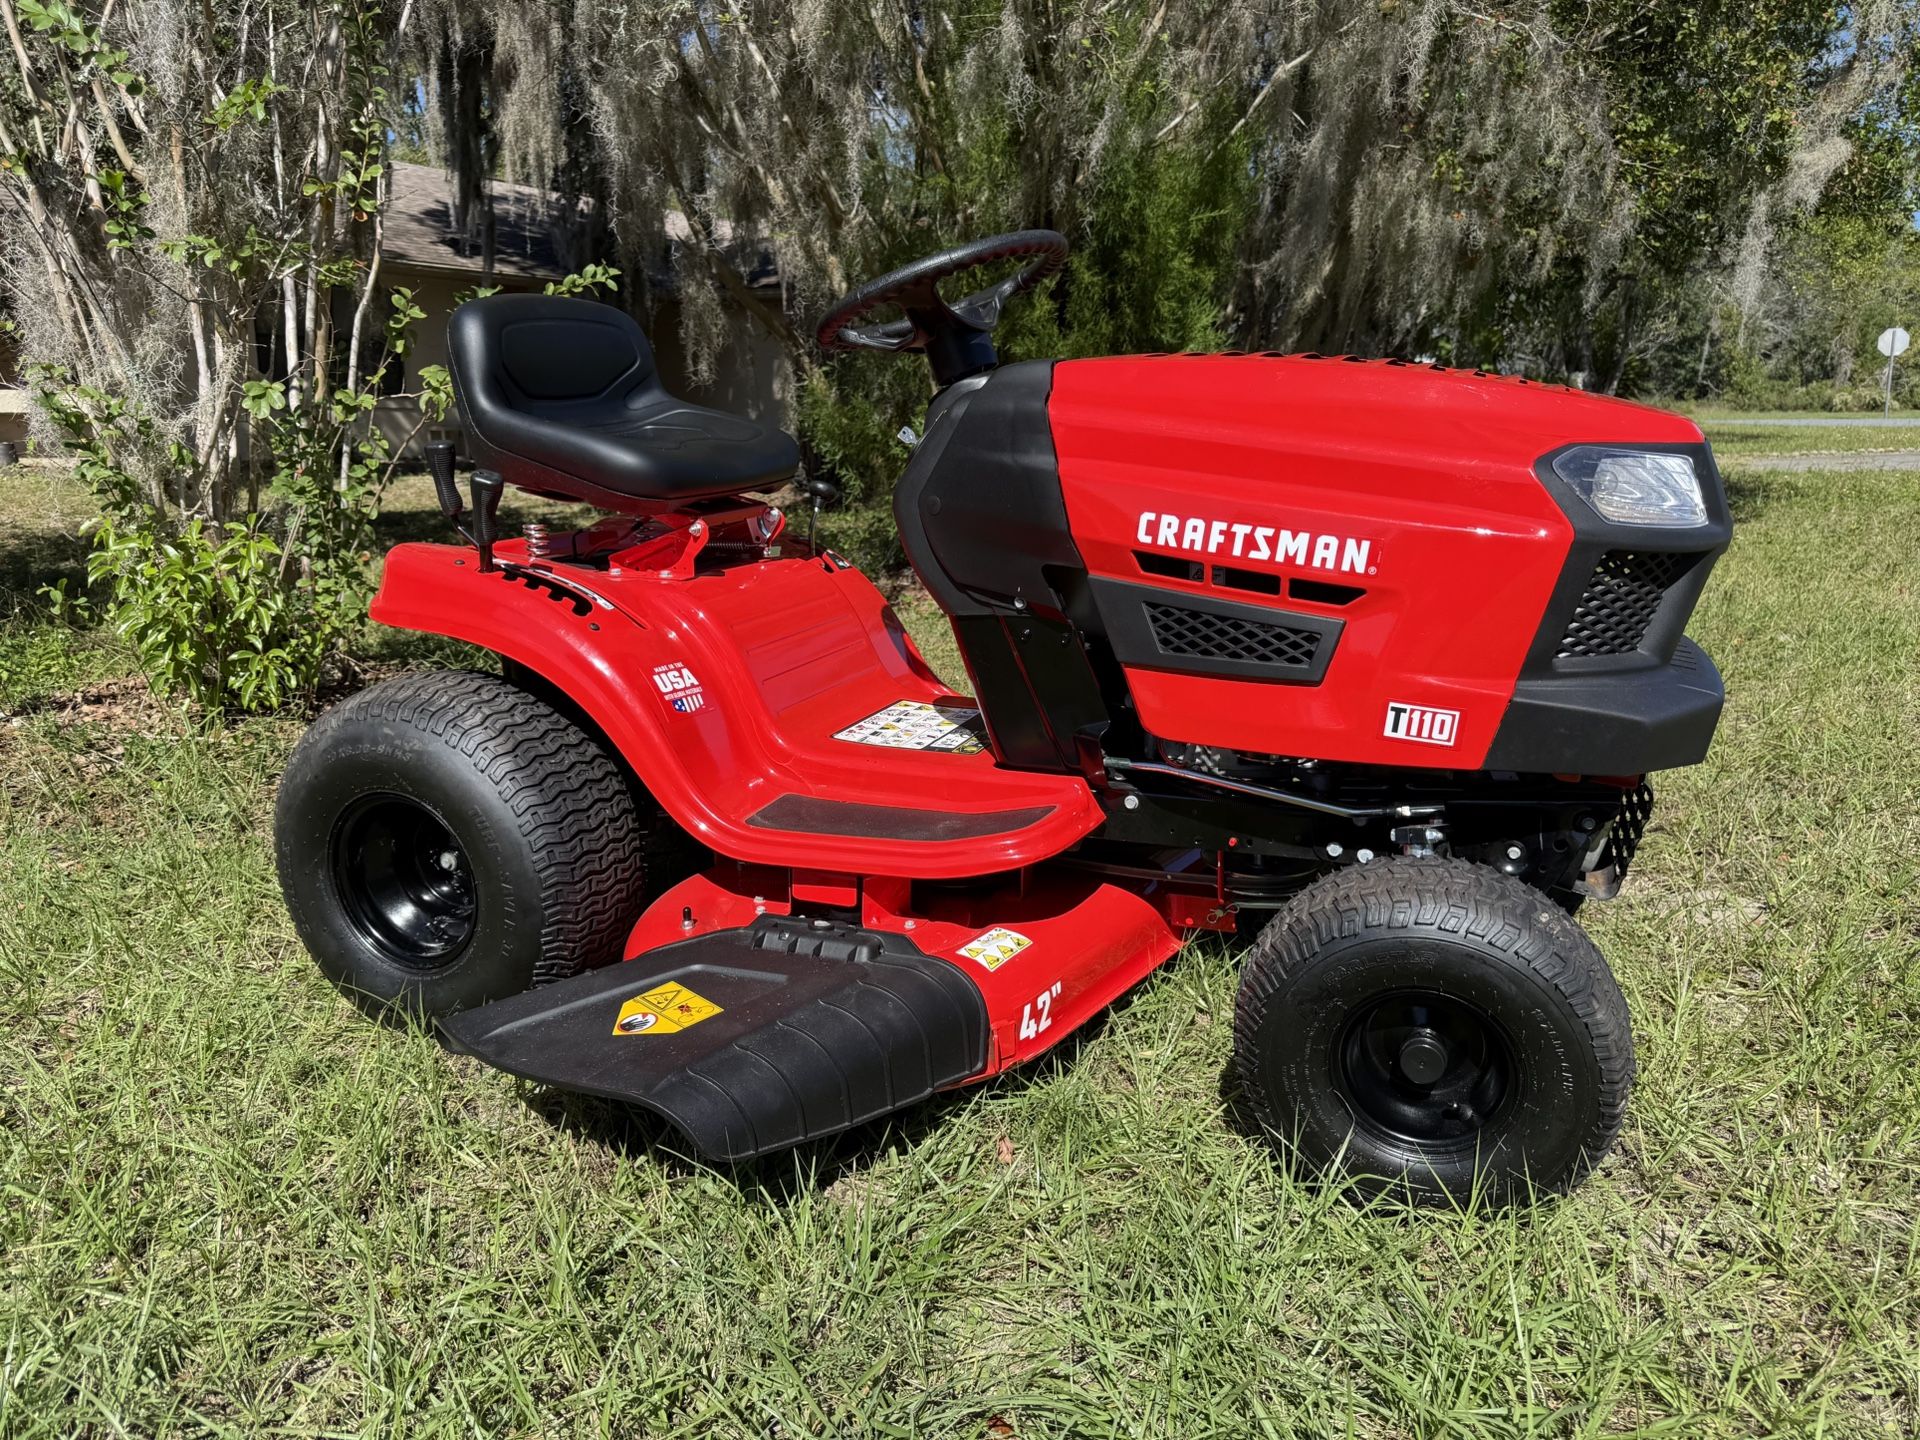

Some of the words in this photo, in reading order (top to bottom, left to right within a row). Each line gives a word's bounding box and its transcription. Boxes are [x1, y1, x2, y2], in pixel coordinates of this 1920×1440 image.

[1137, 511, 1371, 574] CRAFTSMAN
[652, 668, 699, 693] USA
[1386, 704, 1455, 742] T110
[1019, 980, 1062, 1041] 42"
